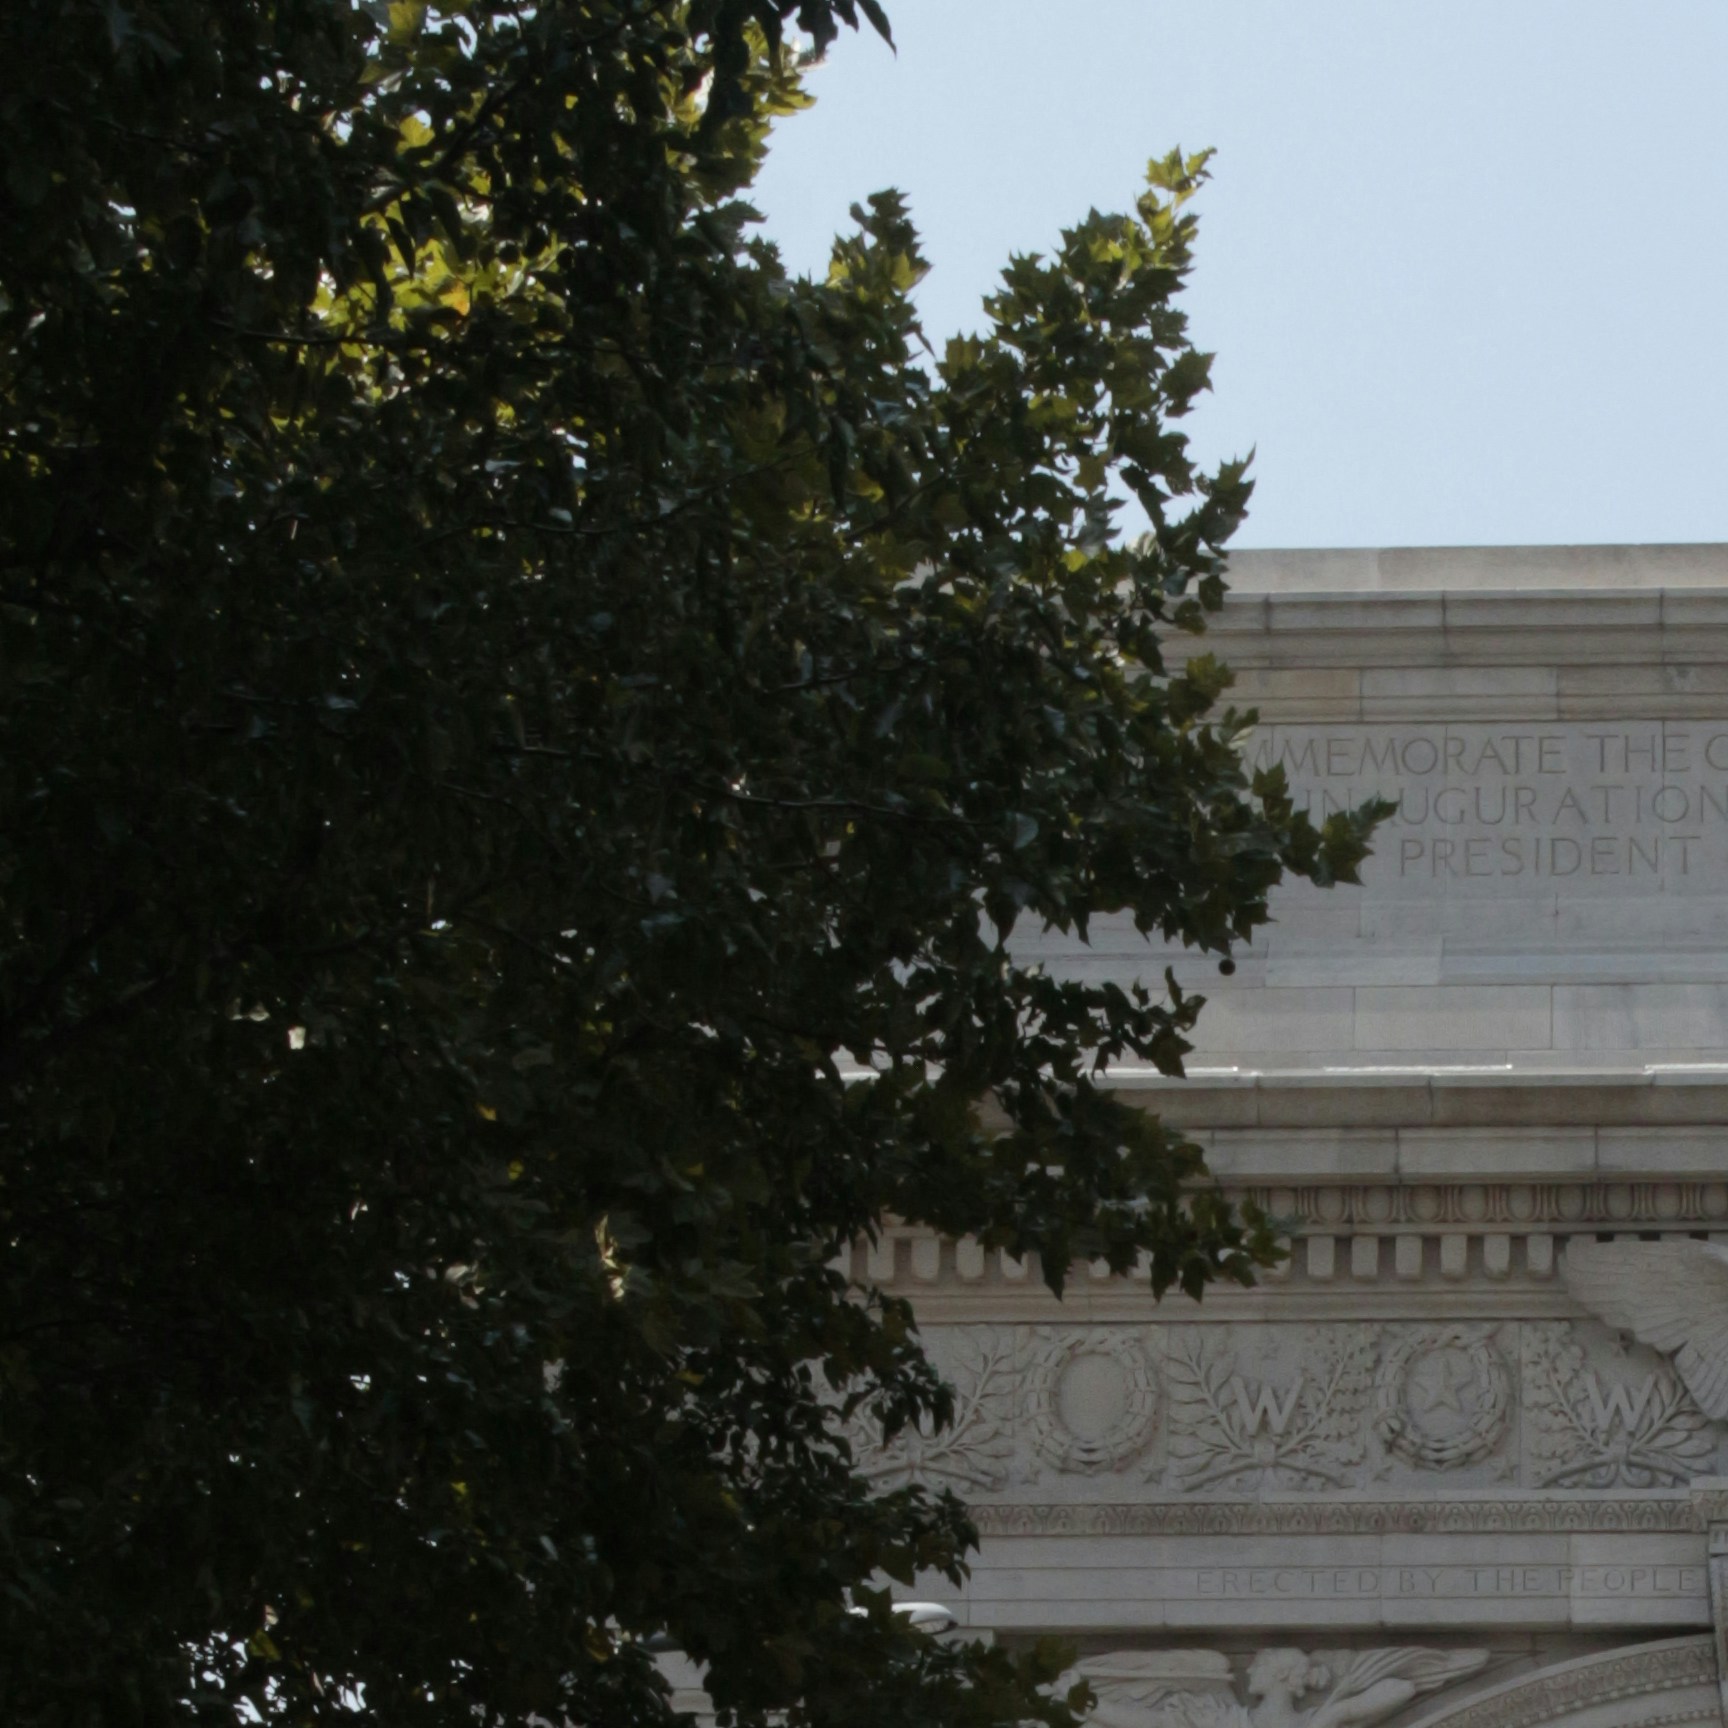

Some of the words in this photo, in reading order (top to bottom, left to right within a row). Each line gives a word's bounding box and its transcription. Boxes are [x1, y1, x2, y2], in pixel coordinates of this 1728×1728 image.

[1586, 733, 1691, 774] THE
[1401, 836, 1701, 878] PRESIDENT
[1231, 1376, 1304, 1434] W
[1587, 1375, 1655, 1432] W
[1197, 1568, 1379, 1594] ERECTED
[1398, 1569, 1444, 1593] BY
[1463, 1568, 1548, 1593] THE
[1557, 1568, 1697, 1593] PEOPLE
